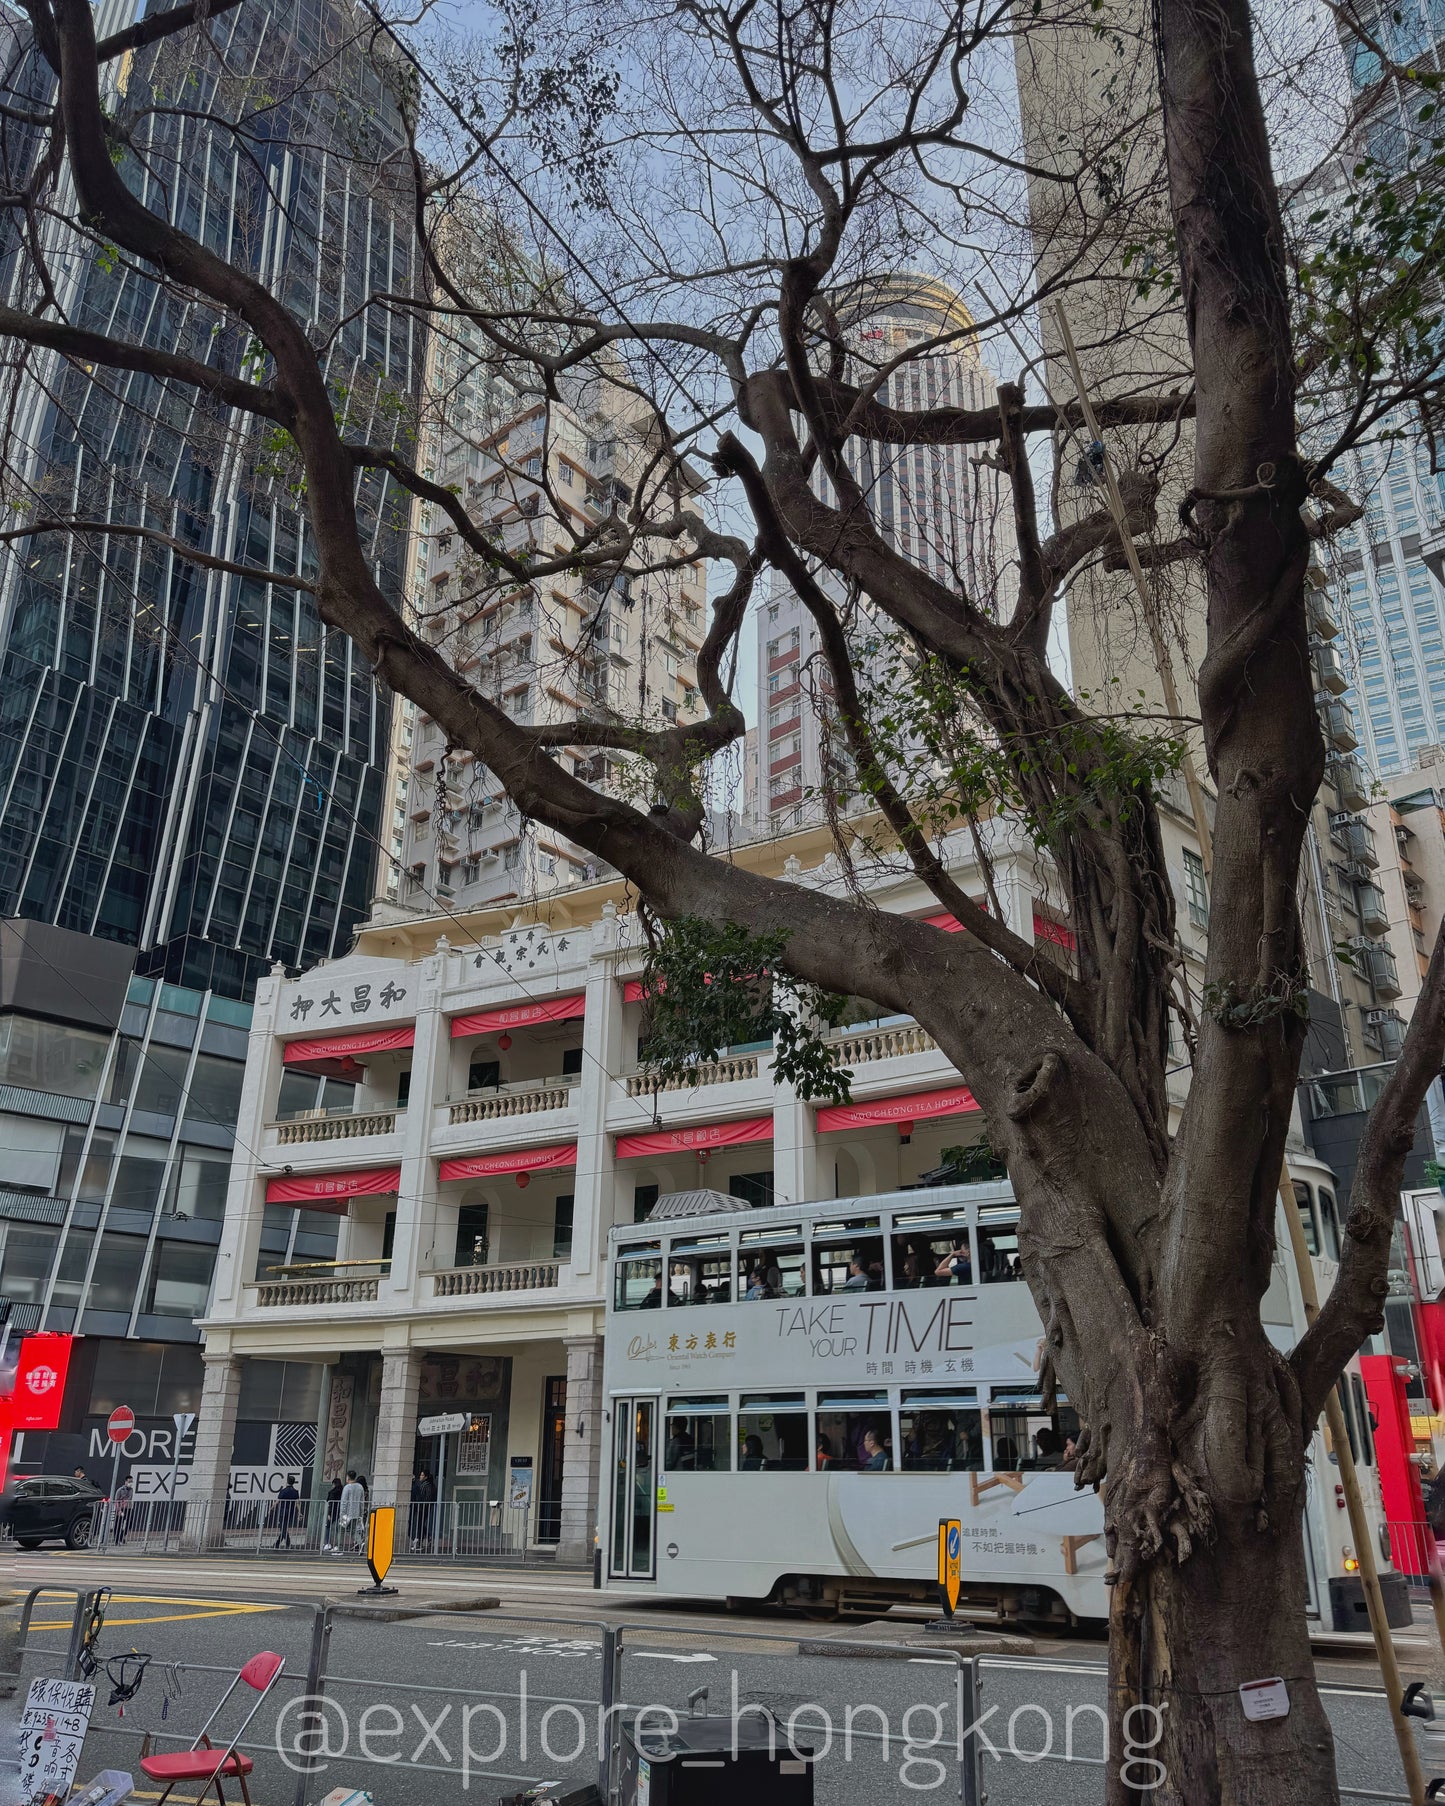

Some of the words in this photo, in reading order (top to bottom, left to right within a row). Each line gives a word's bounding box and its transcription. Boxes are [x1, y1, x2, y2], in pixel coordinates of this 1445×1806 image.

[290, 980, 407, 1021] 和昌大押
[327, 1042, 357, 1052] CHEONG
[358, 1040, 371, 1048] TEA
[850, 1111, 872, 1120] WOO
[874, 1104, 913, 1117] CHEONG
[915, 1102, 933, 1111] TEA
[935, 1096, 968, 1108] HOUSE
[484, 1160, 515, 1170] CHEONG
[517, 1157, 530, 1166] TEA
[776, 1304, 847, 1337] TAKE
[859, 1296, 978, 1355] TIME
[667, 1331, 737, 1352] 東方表行
[809, 1337, 857, 1358] YOUR
[866, 1361, 894, 1376] 時間
[904, 1359, 934, 1375] 時機
[944, 1357, 975, 1373] 玄機
[89, 1428, 196, 1459] MORE
[135, 1472, 301, 1495] EXPENCE
